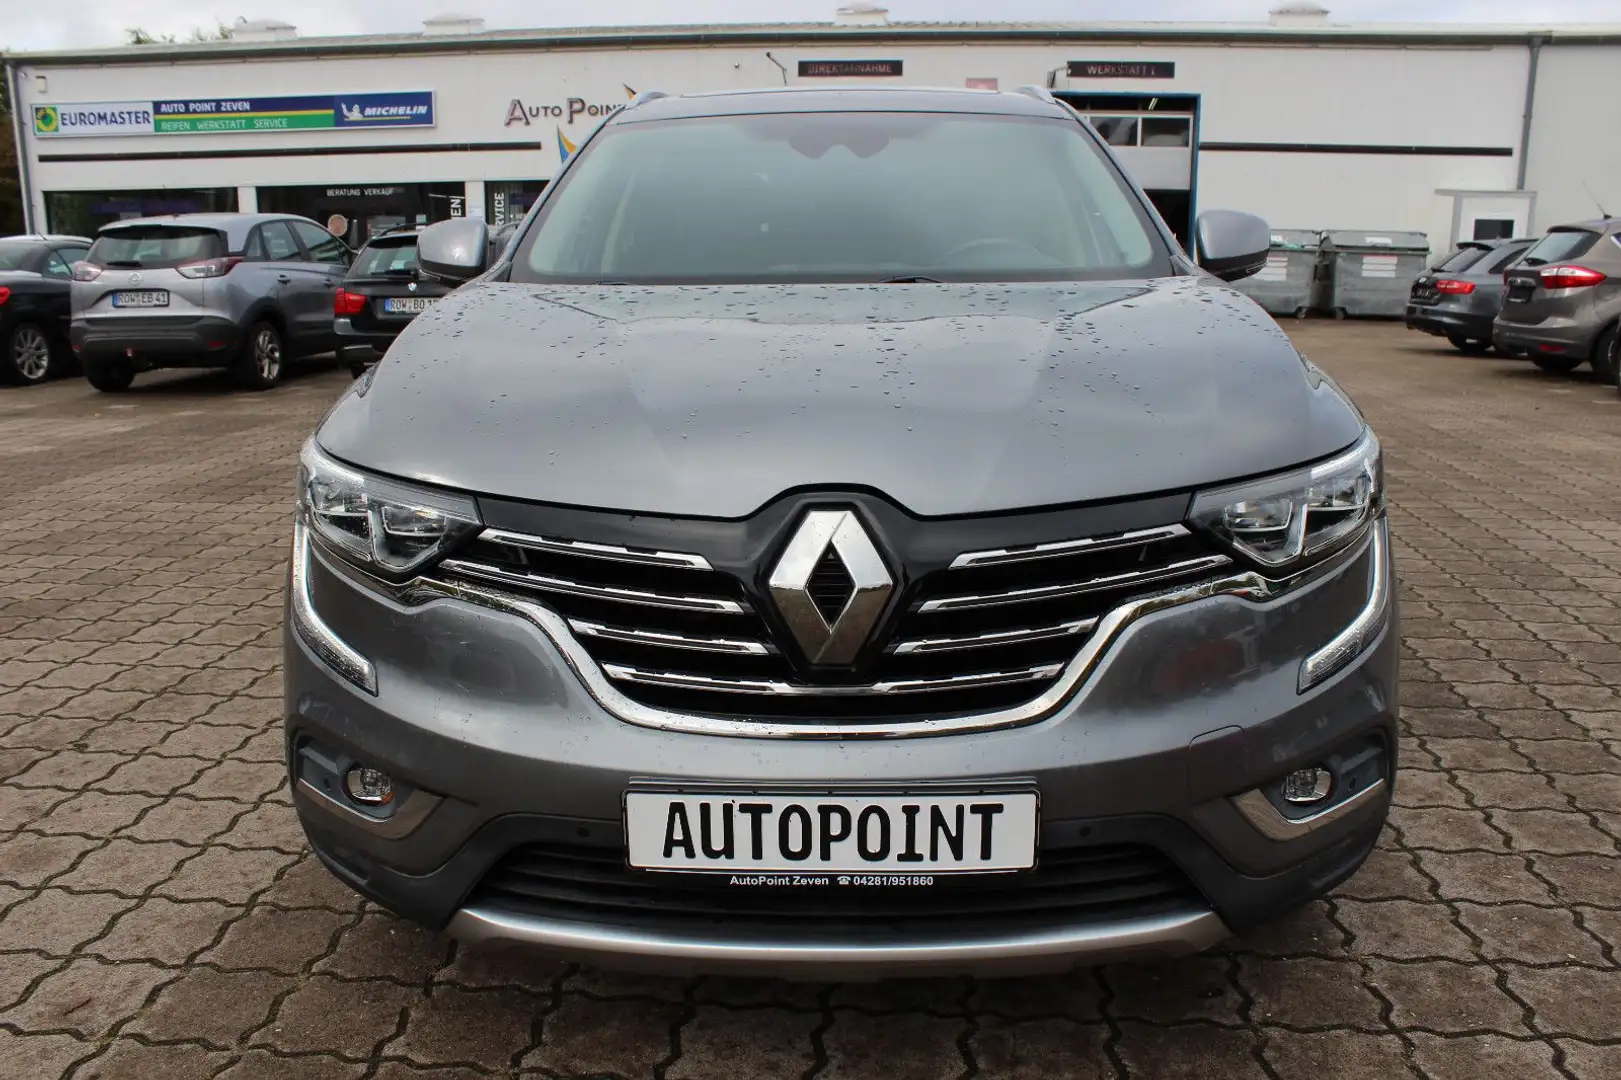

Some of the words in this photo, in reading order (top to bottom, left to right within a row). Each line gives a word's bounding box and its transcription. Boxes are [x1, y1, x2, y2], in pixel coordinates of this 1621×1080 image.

[1086, 64, 1147, 76] WERKSTATT
[160, 103, 185, 113] AUTO
[189, 102, 217, 112] POINT
[221, 101, 250, 112] ZEVEN
[363, 105, 428, 116] MICHELIN
[60, 110, 151, 127] EUROMASTER
[160, 122, 191, 131] REIFEN
[196, 120, 246, 130] WERKSTATT
[254, 118, 288, 129] SERVICE
[326, 189, 361, 197] BERATUNG
[364, 188, 395, 196] VERKAUF
[155, 292, 167, 304] 41
[662, 801, 1005, 862] AUTOPOINT
[729, 875, 790, 886] AutoPoint
[792, 876, 829, 886] Zeven
[853, 876, 934, 886] 04281/951860
